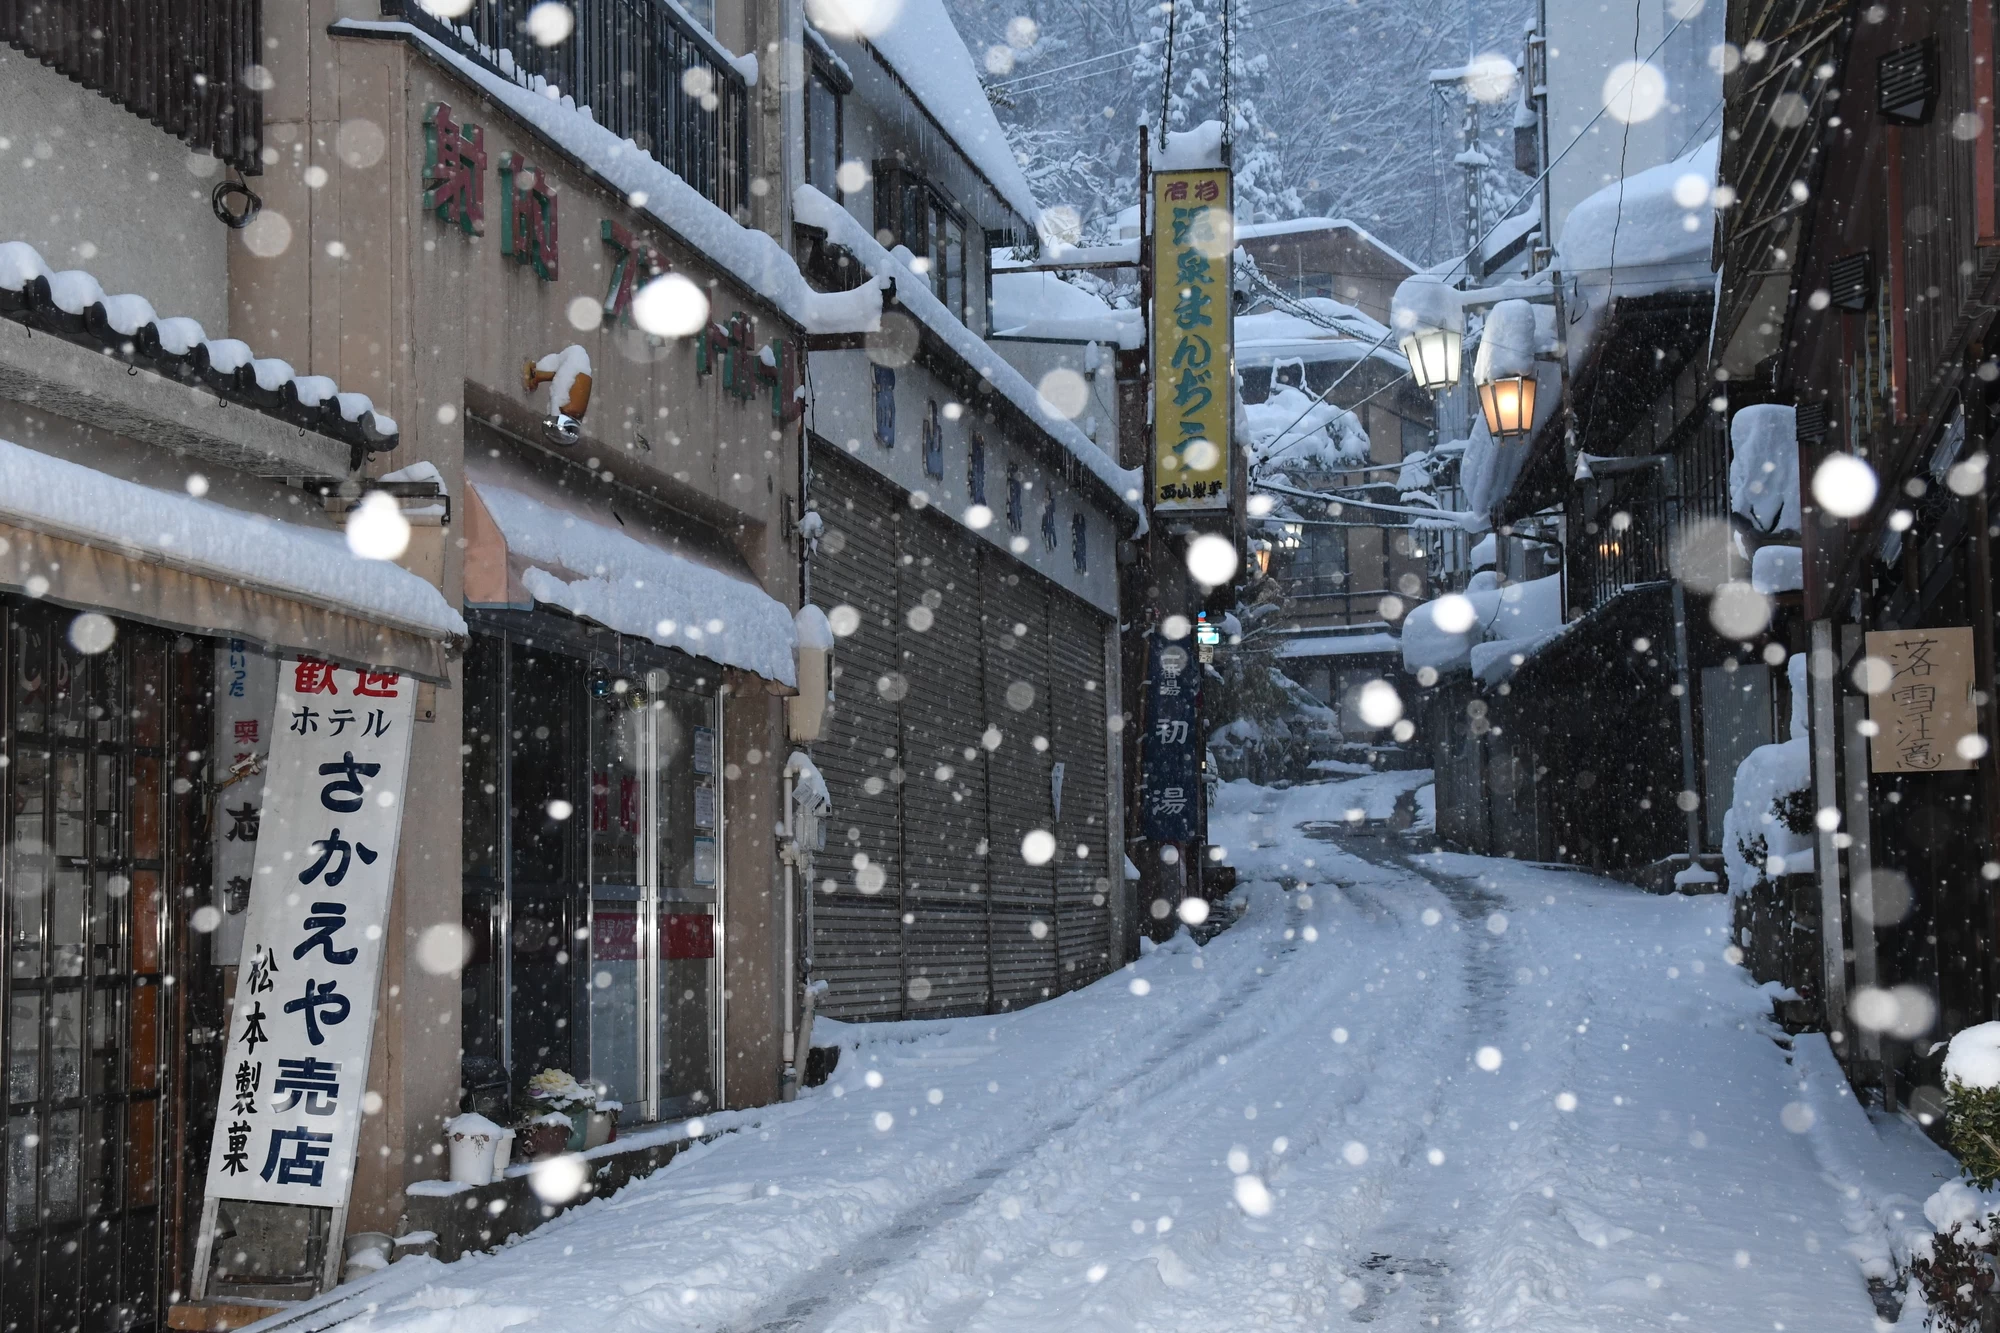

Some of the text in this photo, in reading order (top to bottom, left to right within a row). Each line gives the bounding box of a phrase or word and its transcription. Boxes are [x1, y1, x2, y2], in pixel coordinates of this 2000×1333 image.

[422, 100, 559, 282] 射的
[1163, 179, 1220, 202] 名物
[290, 705, 393, 738] ホテル
[294, 653, 400, 698] 歓迎
[1890, 638, 1942, 770] 落雪注意
[1151, 717, 1189, 816] 初湯
[259, 750, 382, 1188] さかえや売店
[219, 943, 279, 1176] 松本製菓
